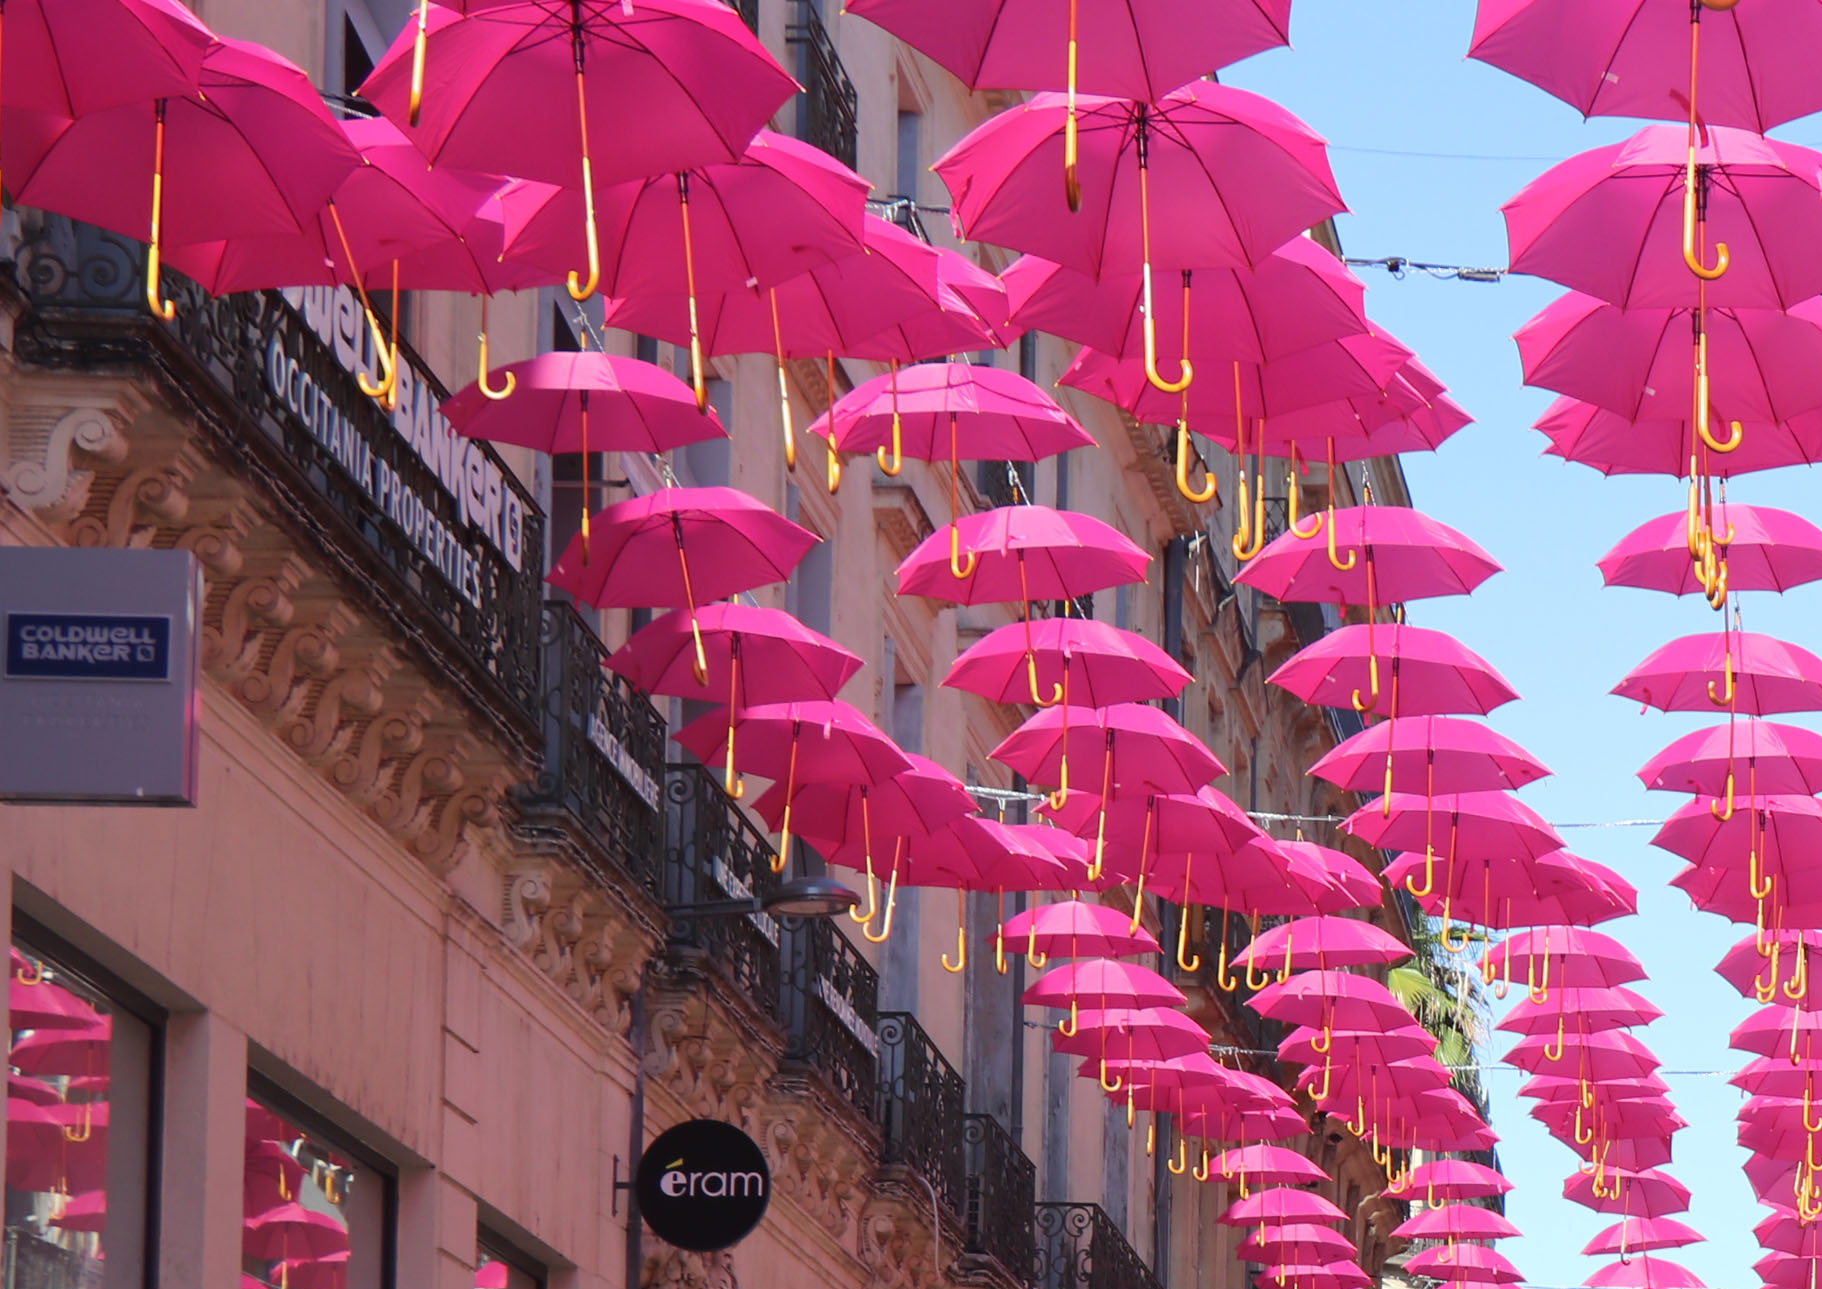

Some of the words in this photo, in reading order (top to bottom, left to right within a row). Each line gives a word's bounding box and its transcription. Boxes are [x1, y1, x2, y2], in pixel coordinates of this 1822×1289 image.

[267, 340, 373, 497] OCCITANIA
[375, 458, 482, 609] PROPERTIES
[20, 625, 157, 645] COLDWELL
[22, 642, 131, 664] BANKER
[660, 1158, 763, 1197] éram
